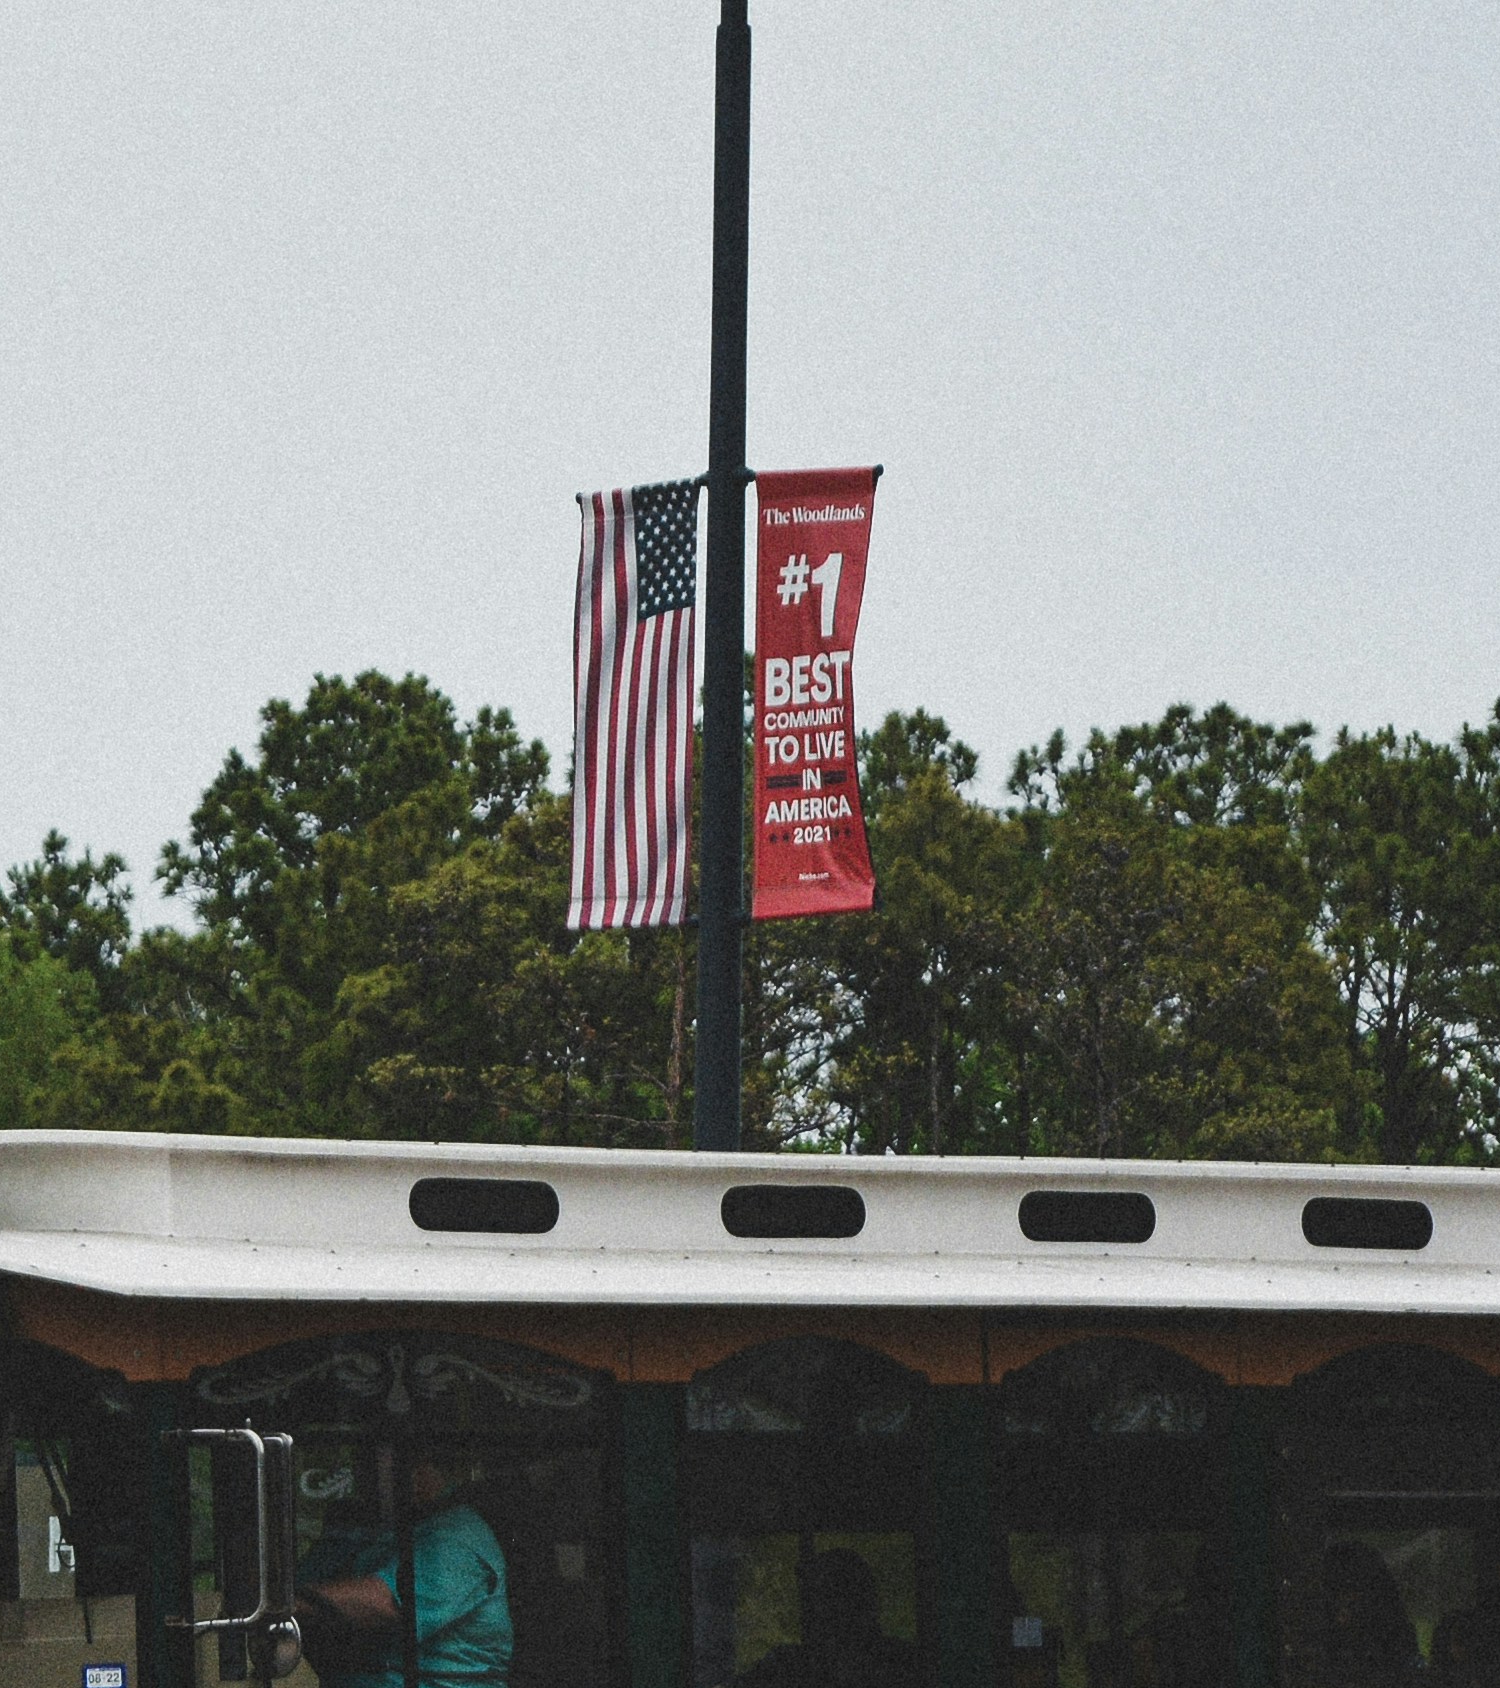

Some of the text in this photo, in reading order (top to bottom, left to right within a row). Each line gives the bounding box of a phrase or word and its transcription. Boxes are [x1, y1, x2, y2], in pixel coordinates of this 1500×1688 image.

[763, 502, 867, 526] The Woodlands
[776, 552, 844, 638] #1
[765, 649, 851, 707] BEST
[764, 705, 845, 731] COMMUNITY
[765, 731, 846, 763] TO LIVE
[802, 769, 822, 792] IN
[765, 794, 852, 824] AMERICA
[793, 825, 832, 846] 2021
